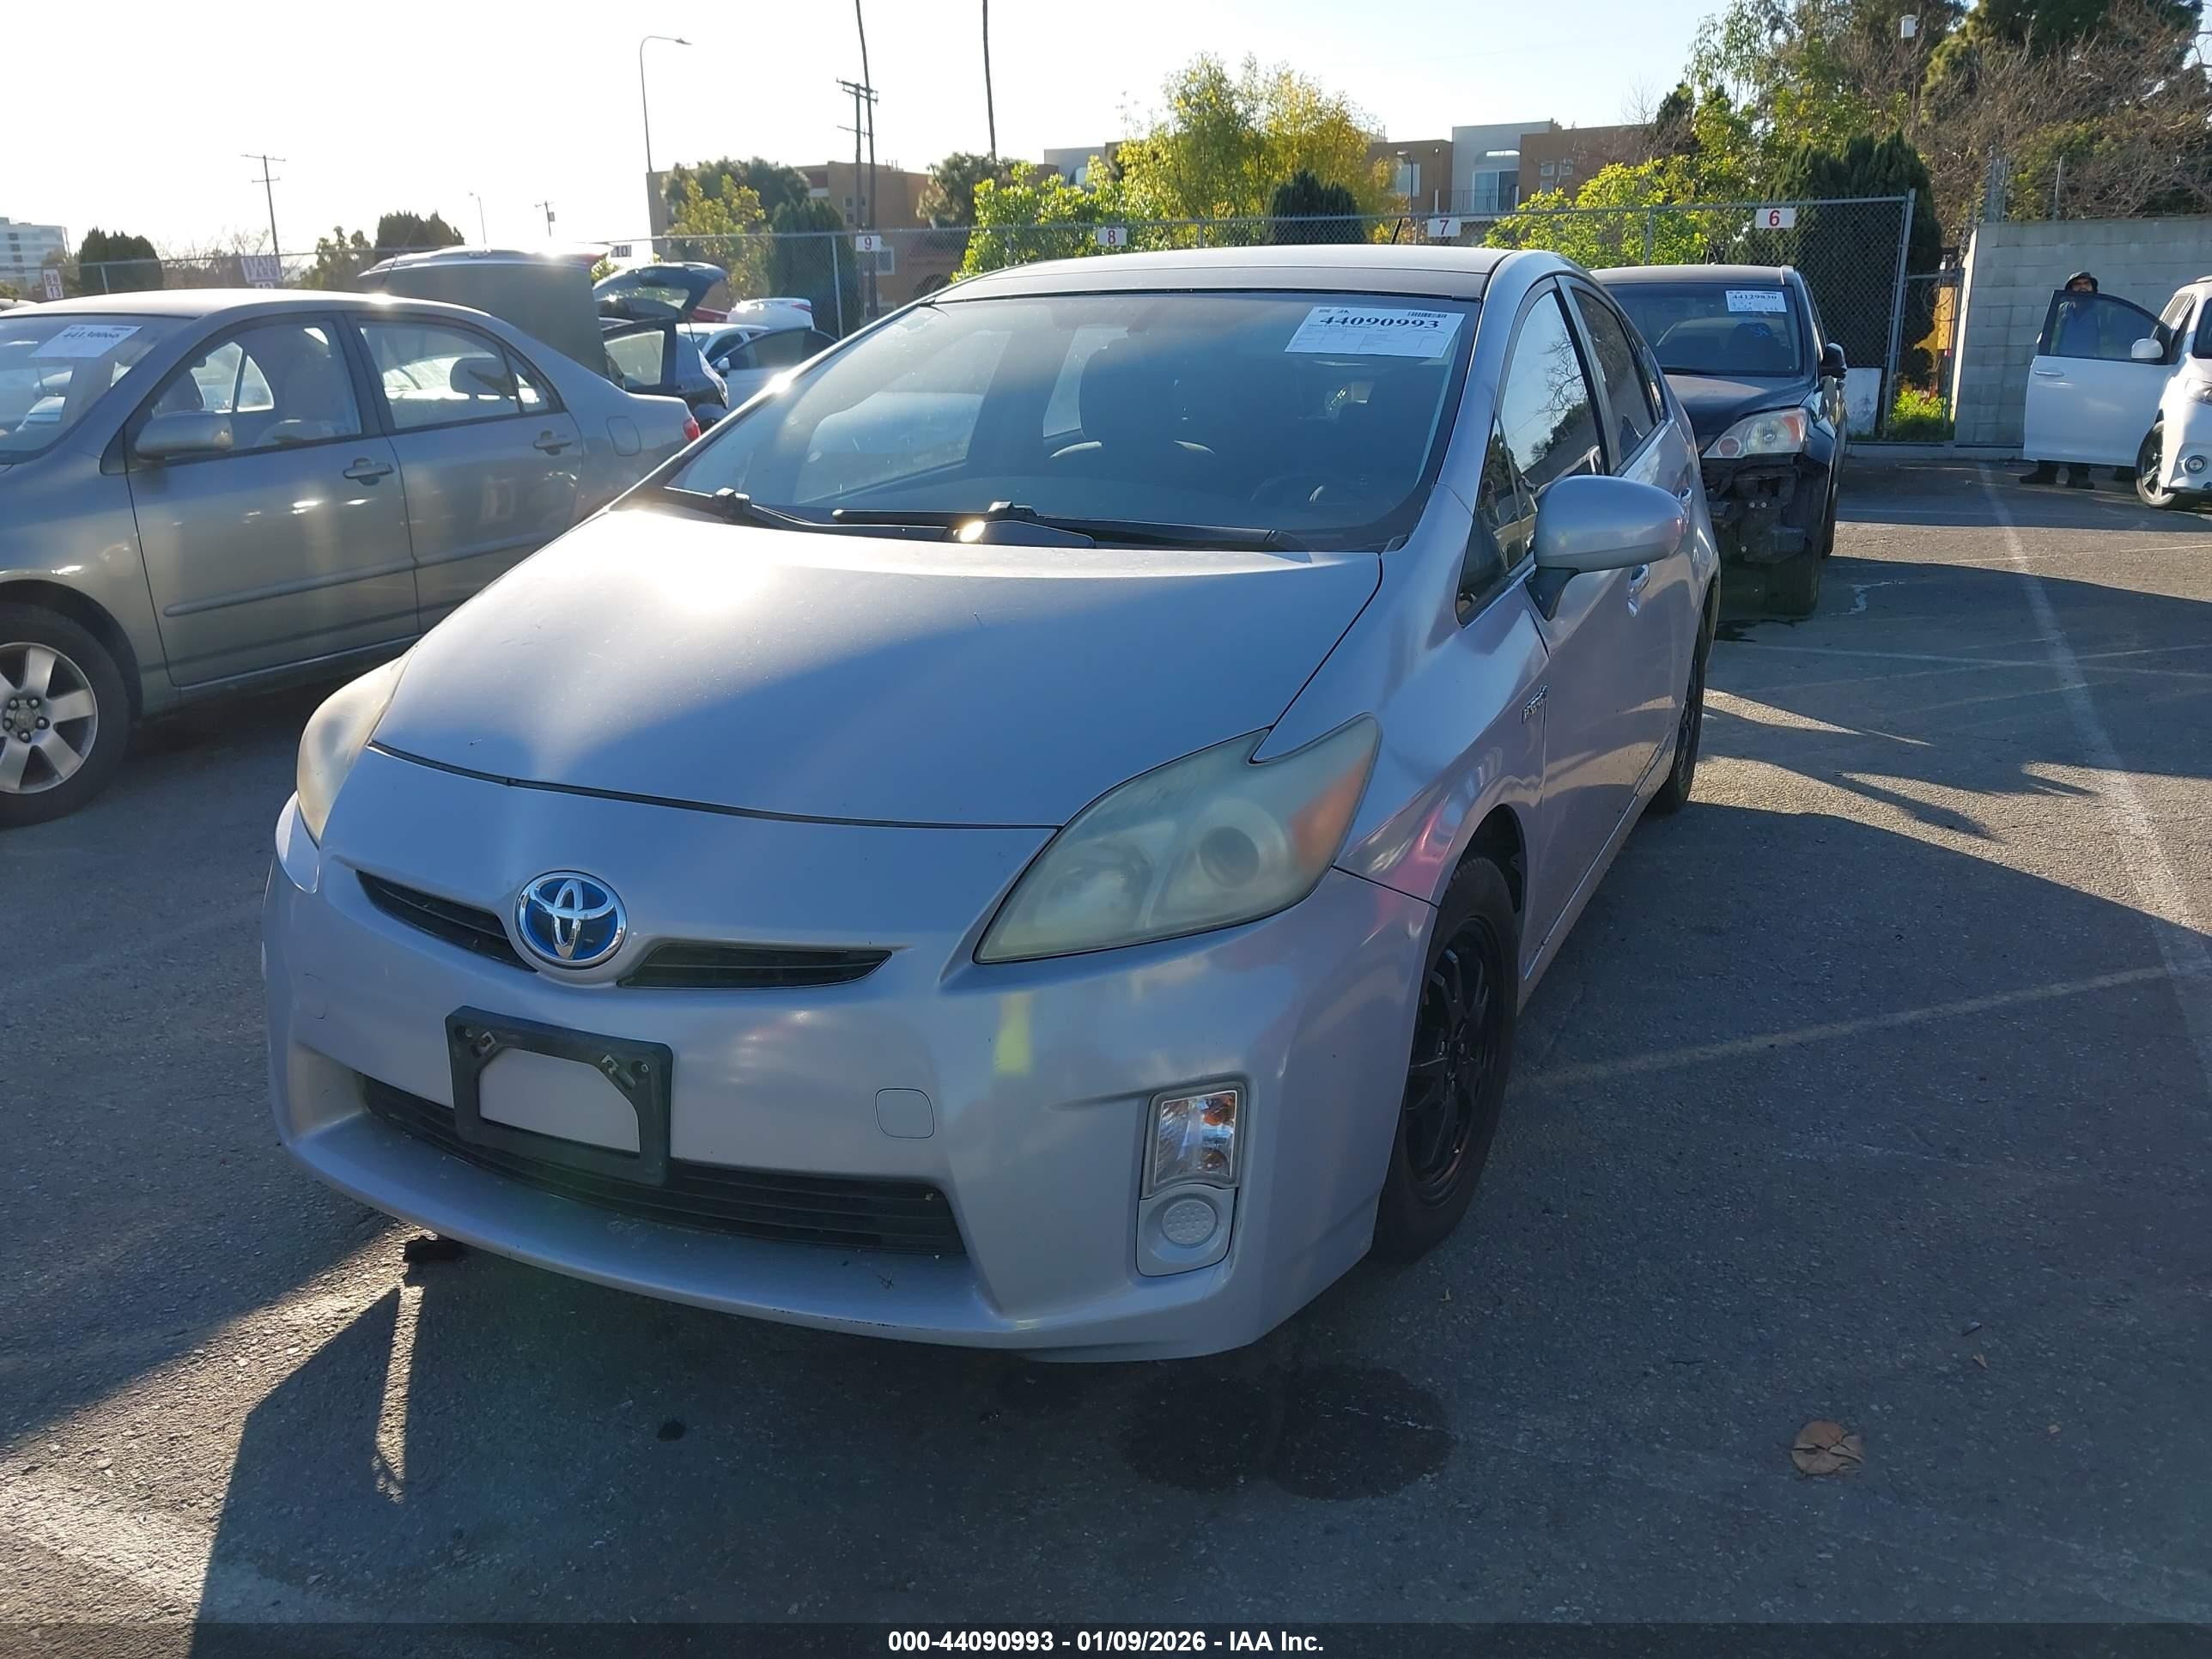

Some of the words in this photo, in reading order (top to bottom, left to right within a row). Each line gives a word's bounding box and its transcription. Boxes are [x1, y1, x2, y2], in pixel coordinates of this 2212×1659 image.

[1769, 210, 1780, 227] 6
[1439, 219, 1449, 235] 7
[865, 237, 872, 250] 9
[1108, 229, 1115, 244] 8
[614, 246, 628, 257] 10
[1319, 315, 1440, 330] 44090993
